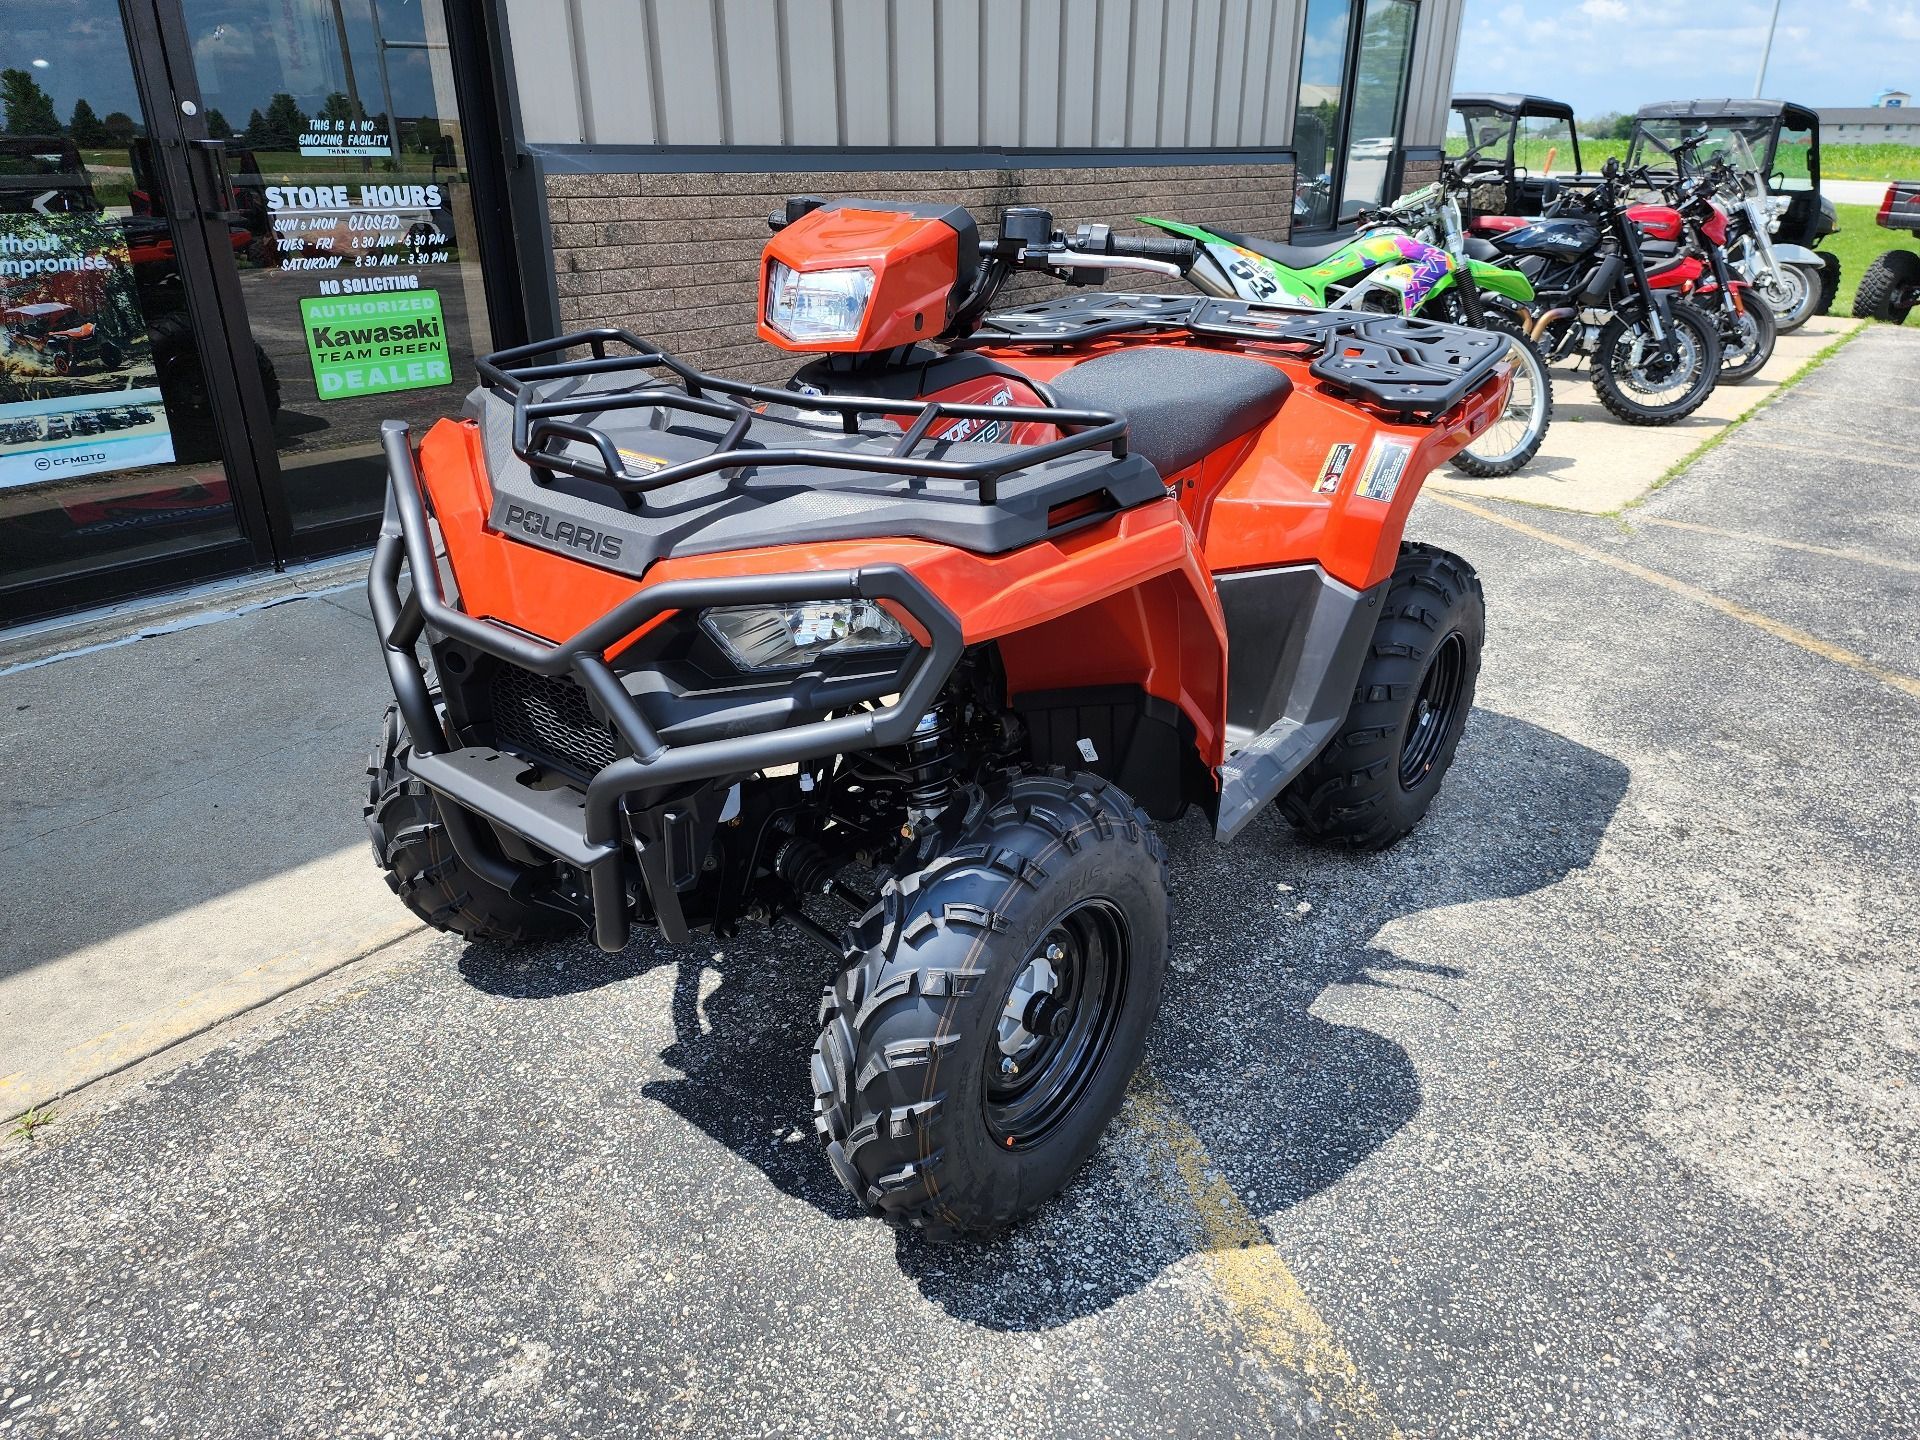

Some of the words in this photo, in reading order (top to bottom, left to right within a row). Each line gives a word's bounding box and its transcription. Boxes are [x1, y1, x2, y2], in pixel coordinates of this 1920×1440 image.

[309, 120, 330, 131] THIS
[335, 120, 344, 131] IS
[350, 120, 356, 131] A
[298, 134, 343, 146] SMOKING
[348, 134, 389, 146] FACILITY
[265, 186, 350, 209] STORE
[360, 185, 441, 207] HOURS
[273, 218, 298, 232] SUN
[300, 221, 306, 230] &
[309, 217, 337, 230] MON
[348, 215, 400, 231] CLOSED
[277, 238, 305, 252] TUES
[315, 237, 335, 249] FRI
[376, 235, 395, 248] AM
[428, 234, 446, 245] PM
[281, 255, 343, 271] SATURDAY
[379, 254, 399, 266] AM
[431, 252, 449, 263] PM
[320, 280, 340, 295] NO
[343, 274, 419, 293] SOLICITING
[309, 297, 435, 318] AUTHORIZED
[312, 317, 440, 348] Kawasaki
[318, 349, 372, 363] TEAM
[379, 341, 441, 357] GREEN
[320, 360, 446, 392] DEALER
[53, 453, 106, 467] CFMOTO
[504, 504, 623, 560] POLARIS
